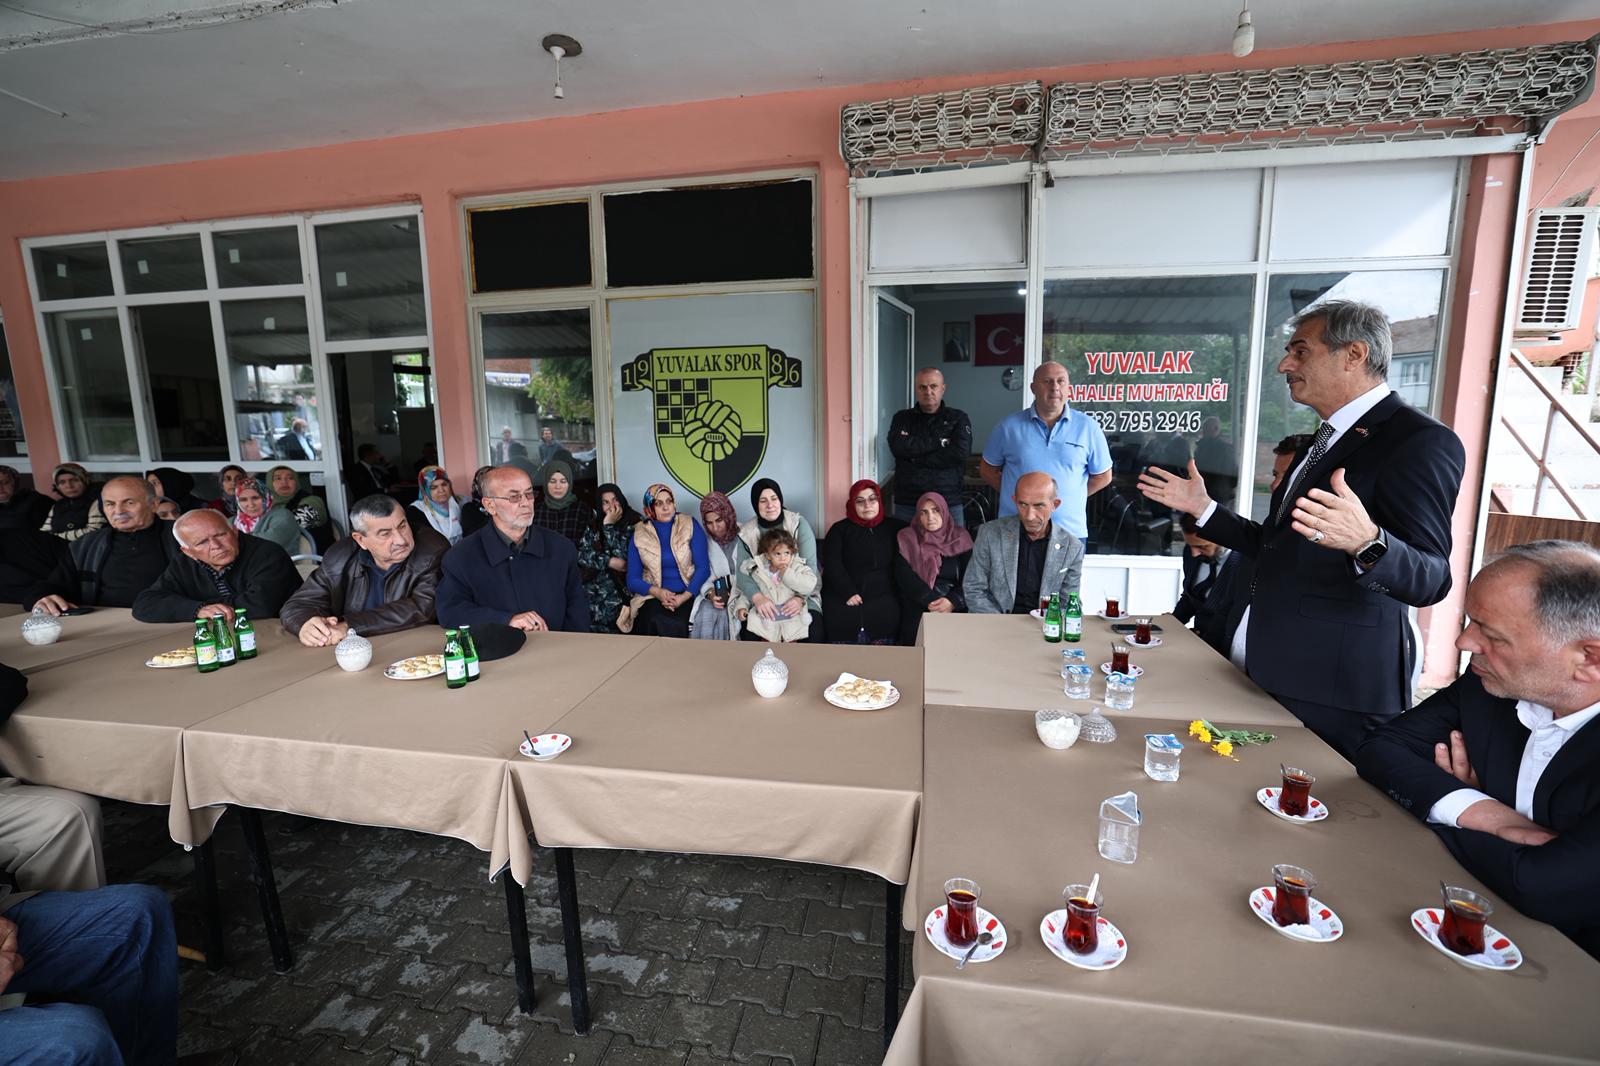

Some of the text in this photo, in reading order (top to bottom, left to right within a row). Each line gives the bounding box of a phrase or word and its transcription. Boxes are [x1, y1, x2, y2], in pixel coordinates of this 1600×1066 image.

[657, 355, 721, 373] YUVALAK
[725, 353, 762, 371] SPOR
[1085, 351, 1193, 375] YUVALAK
[1067, 378, 1229, 402] AHALLE MUHTARLIĞI
[1120, 411, 1152, 432] 795
[1155, 411, 1200, 432] 2946
